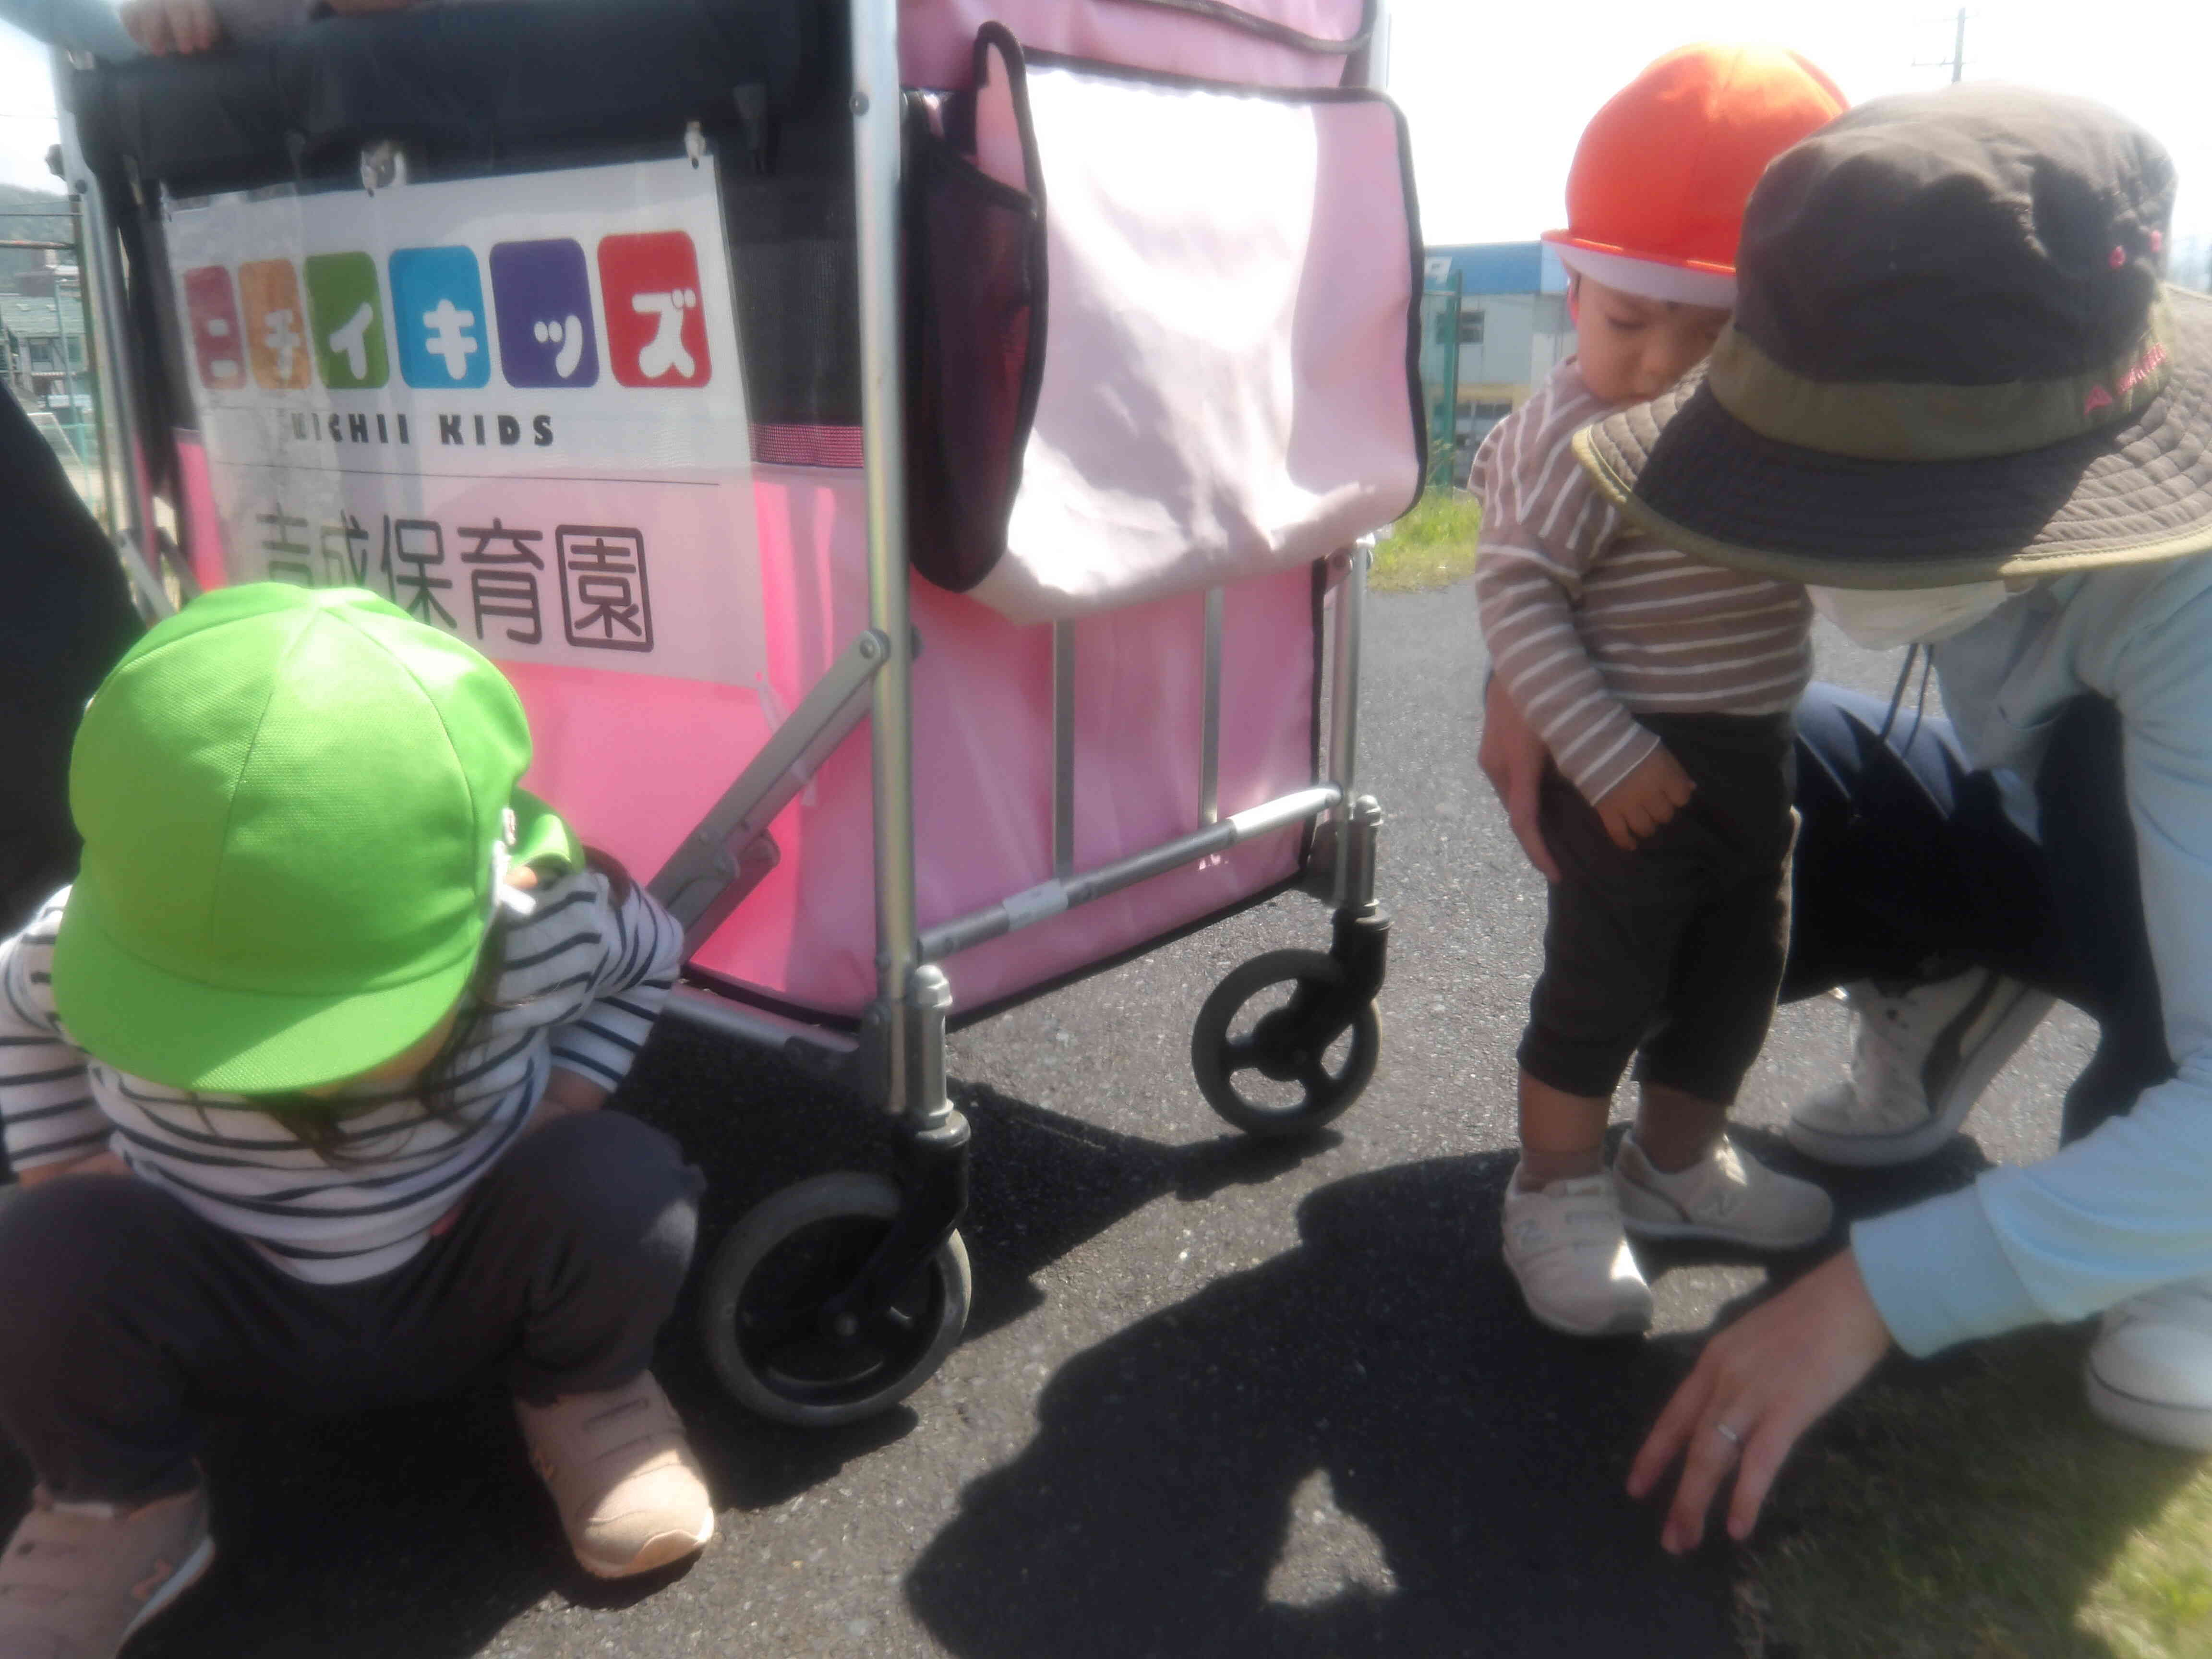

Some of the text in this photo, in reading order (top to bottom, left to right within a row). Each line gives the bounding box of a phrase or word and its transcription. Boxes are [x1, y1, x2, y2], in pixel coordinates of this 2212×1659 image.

[207, 288, 696, 380] ニチイキッズ
[439, 414, 553, 445] KIDS
